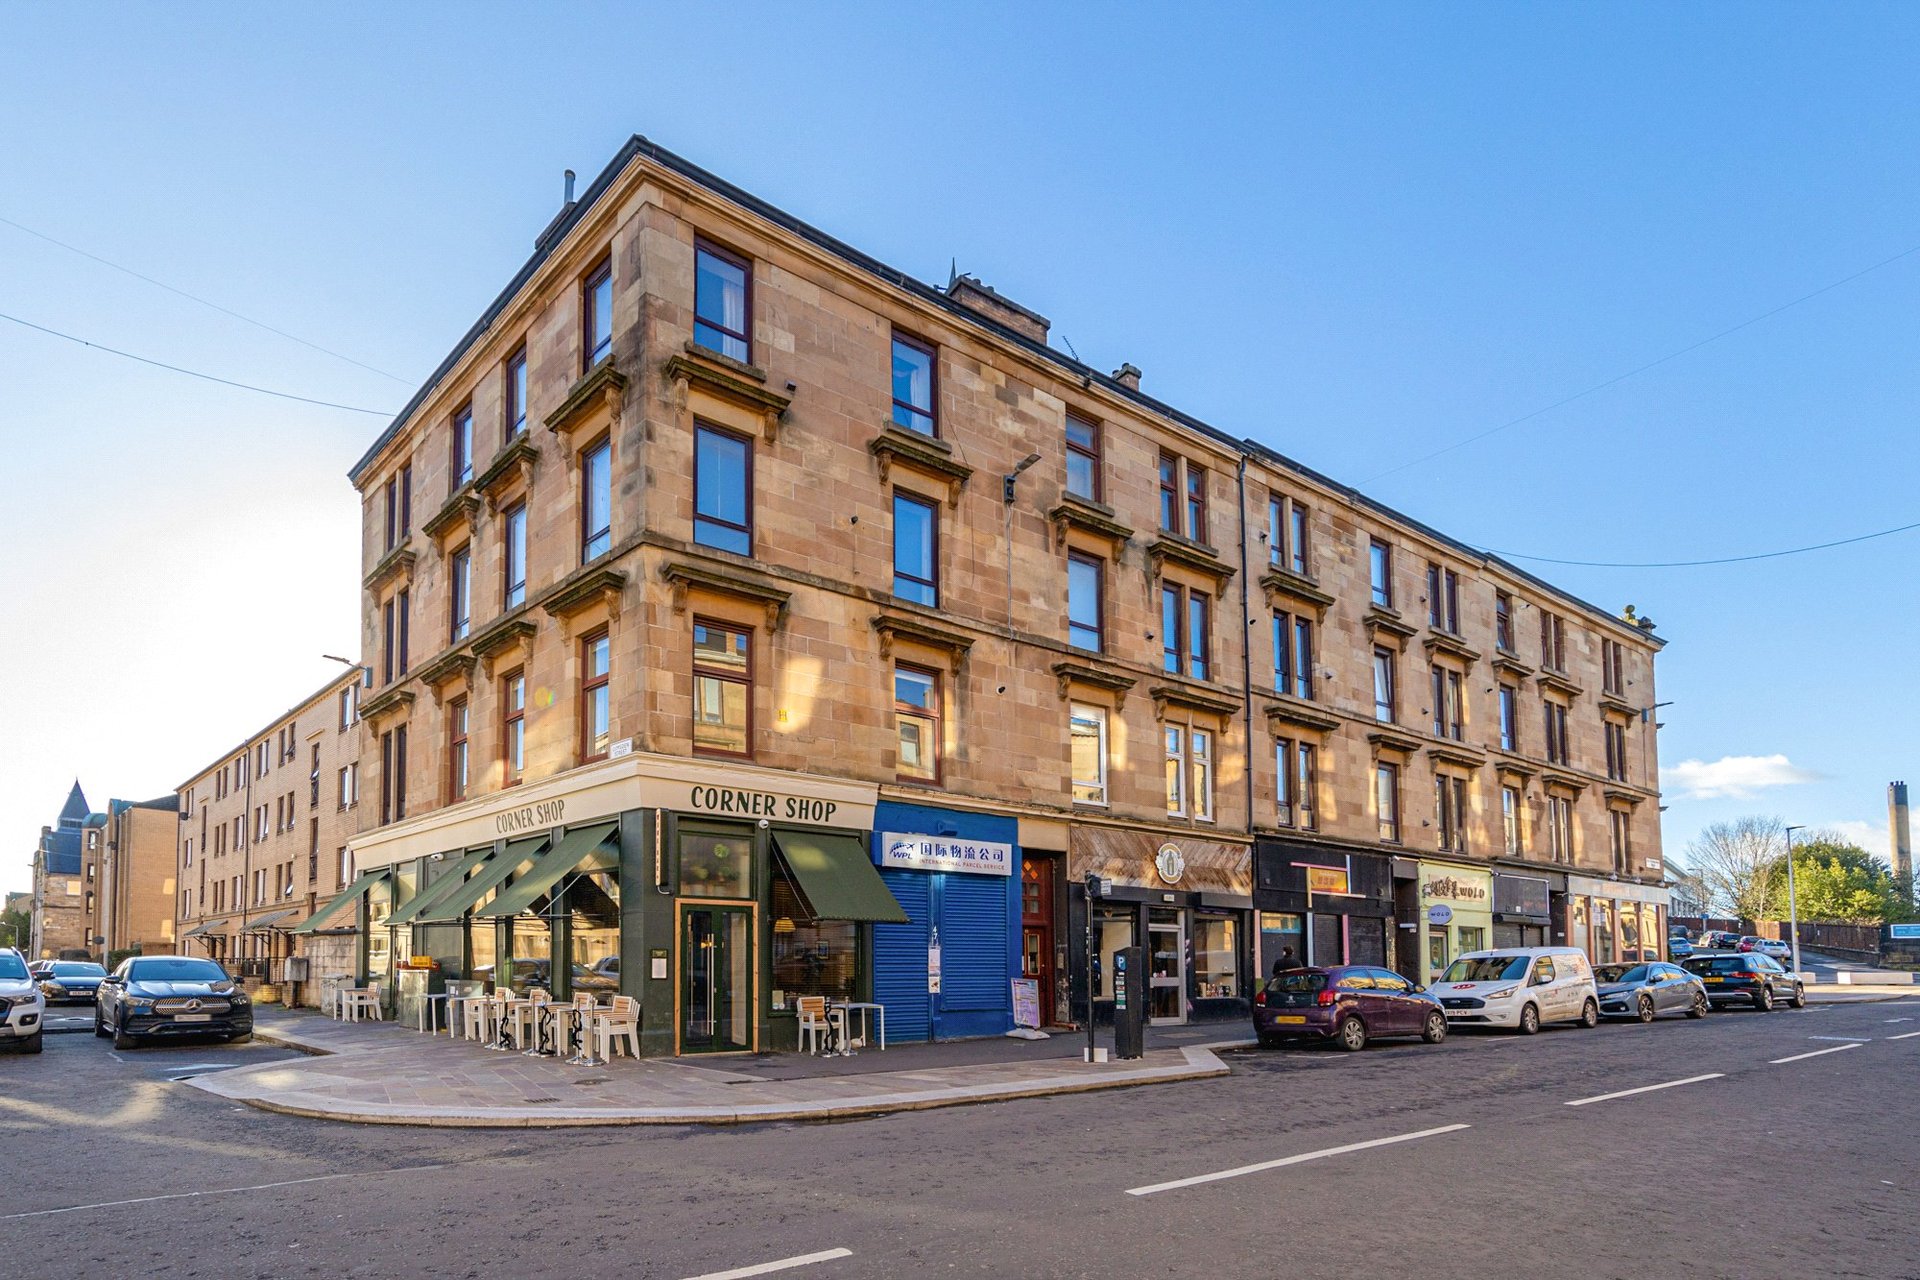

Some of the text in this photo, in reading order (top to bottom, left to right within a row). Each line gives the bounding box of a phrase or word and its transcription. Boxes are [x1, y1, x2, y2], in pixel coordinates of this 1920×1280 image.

[691, 786, 836, 822] CORNER SHOP
[496, 799, 565, 834] CORNER SHOP
[893, 851, 913, 860] WPL
[920, 842, 1004, 862] 国际物流公司
[921, 858, 961, 868] INTERNATIONAL
